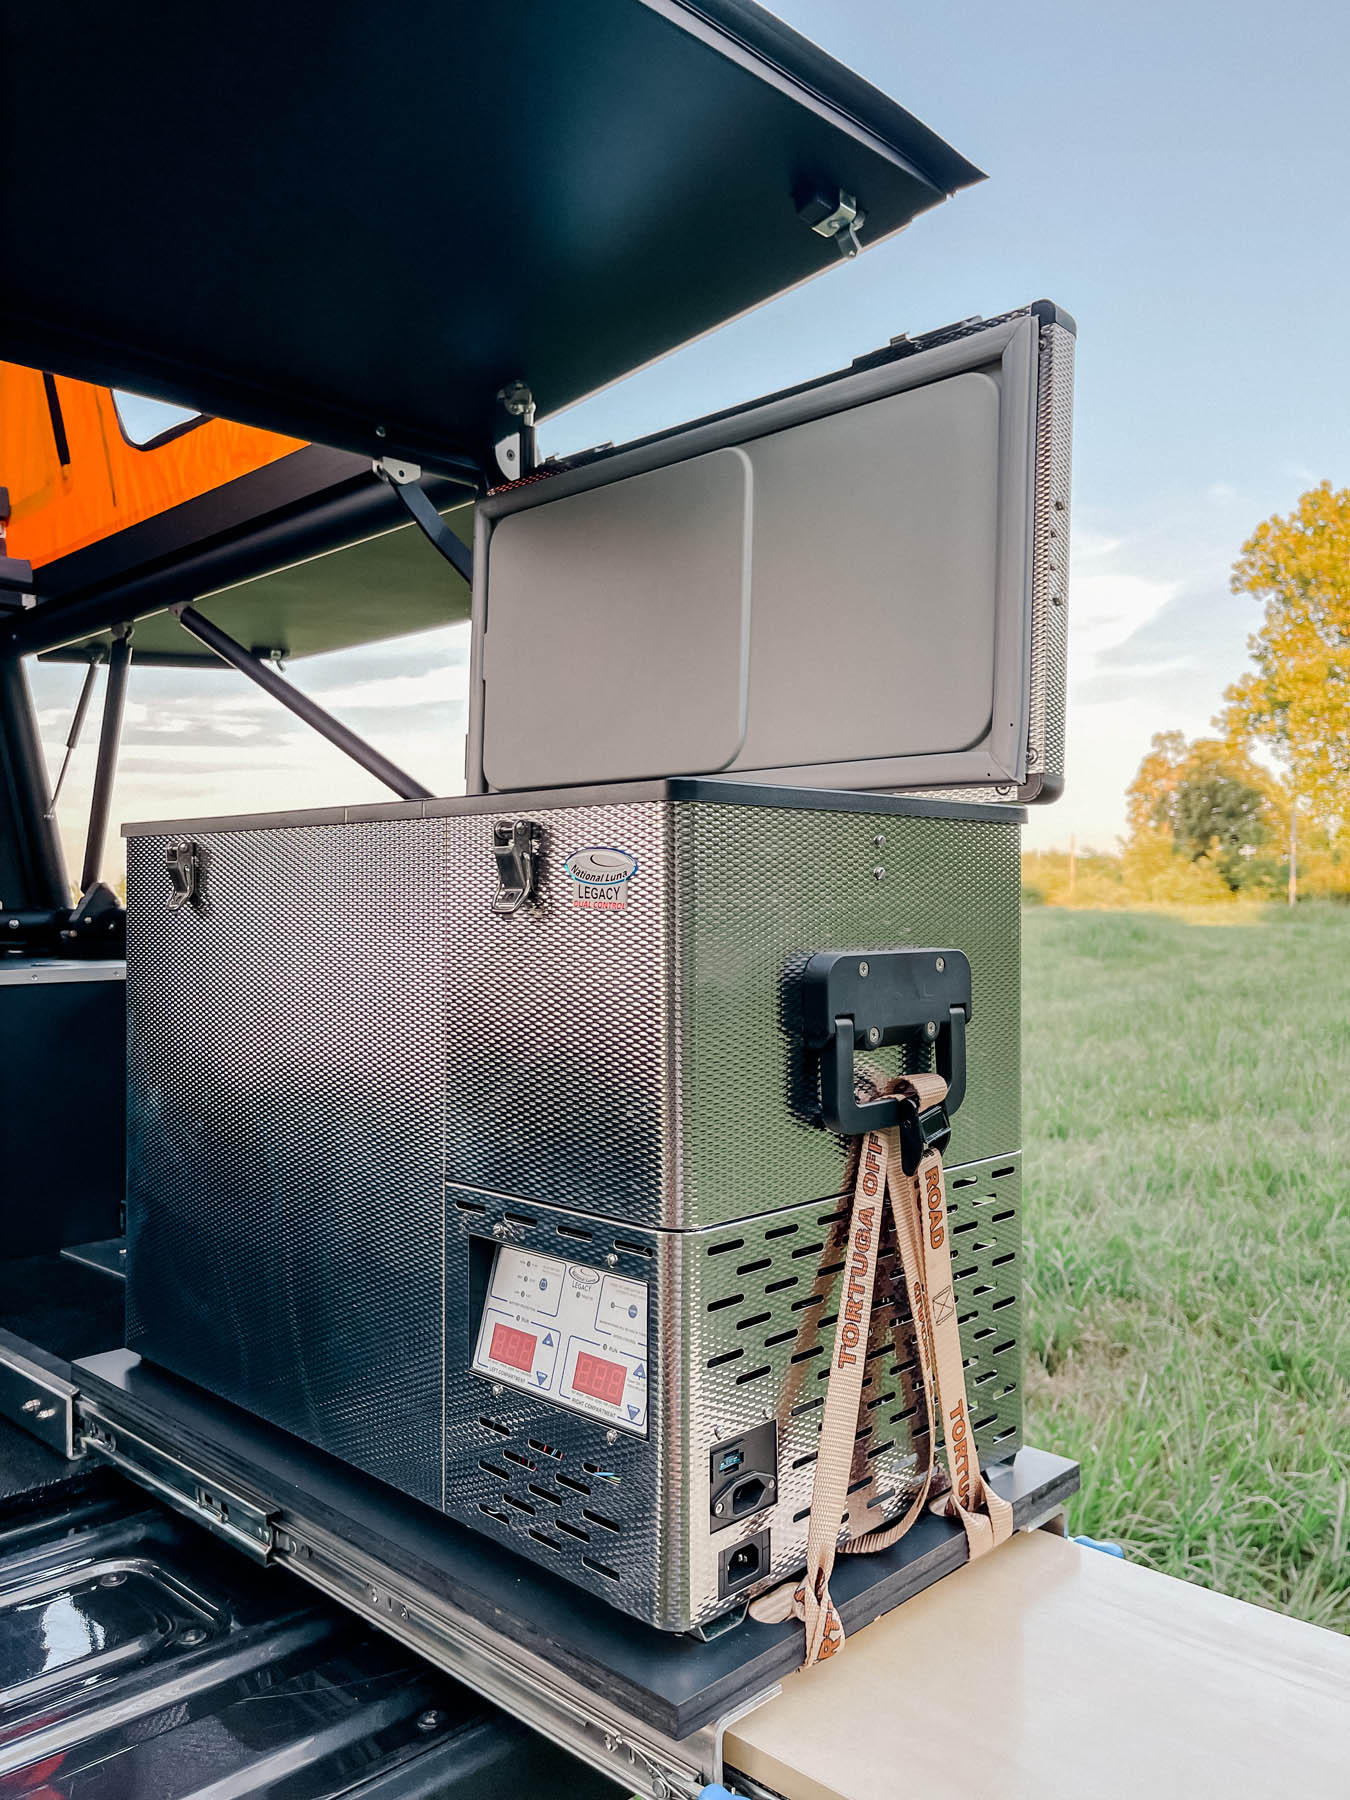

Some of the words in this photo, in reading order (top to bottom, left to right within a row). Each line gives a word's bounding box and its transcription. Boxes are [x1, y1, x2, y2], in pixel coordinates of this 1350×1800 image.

[571, 864, 604, 882] National
[605, 870, 628, 882] Luna
[578, 884, 620, 900] LEGACY
[573, 900, 591, 908] DUAL
[593, 901, 625, 910] CONTROL
[924, 1165, 945, 1250] ROAD
[838, 1206, 876, 1368] TORTUGA
[862, 1131, 883, 1197] OFF
[571, 1281, 592, 1292] LEGACY
